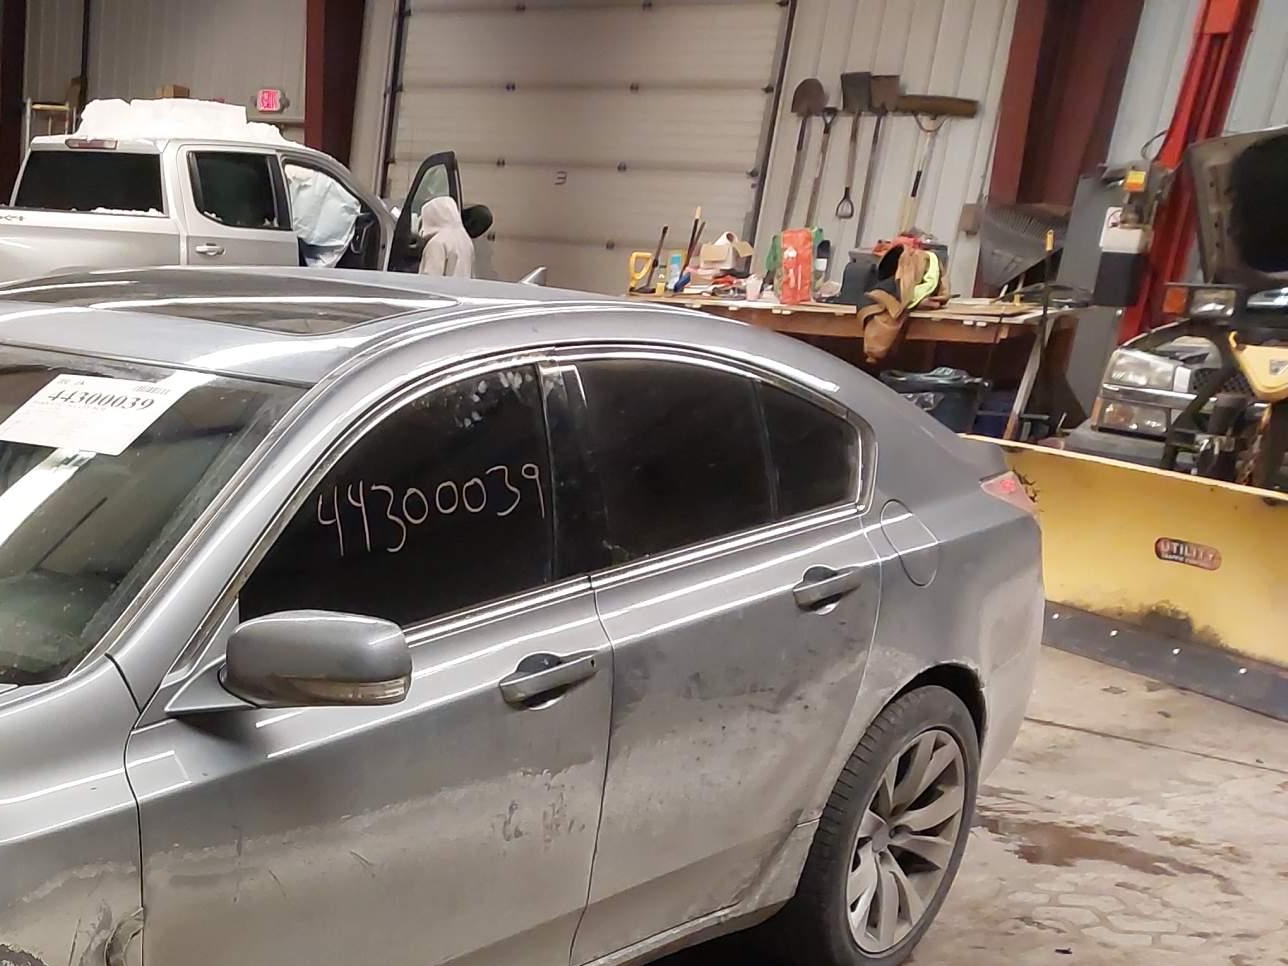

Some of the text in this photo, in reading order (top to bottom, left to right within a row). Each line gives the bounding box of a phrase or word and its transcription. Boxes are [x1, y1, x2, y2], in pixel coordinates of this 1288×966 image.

[554, 171, 568, 185] 3
[48, 390, 155, 410] 44300039
[317, 463, 546, 557] 44300039
